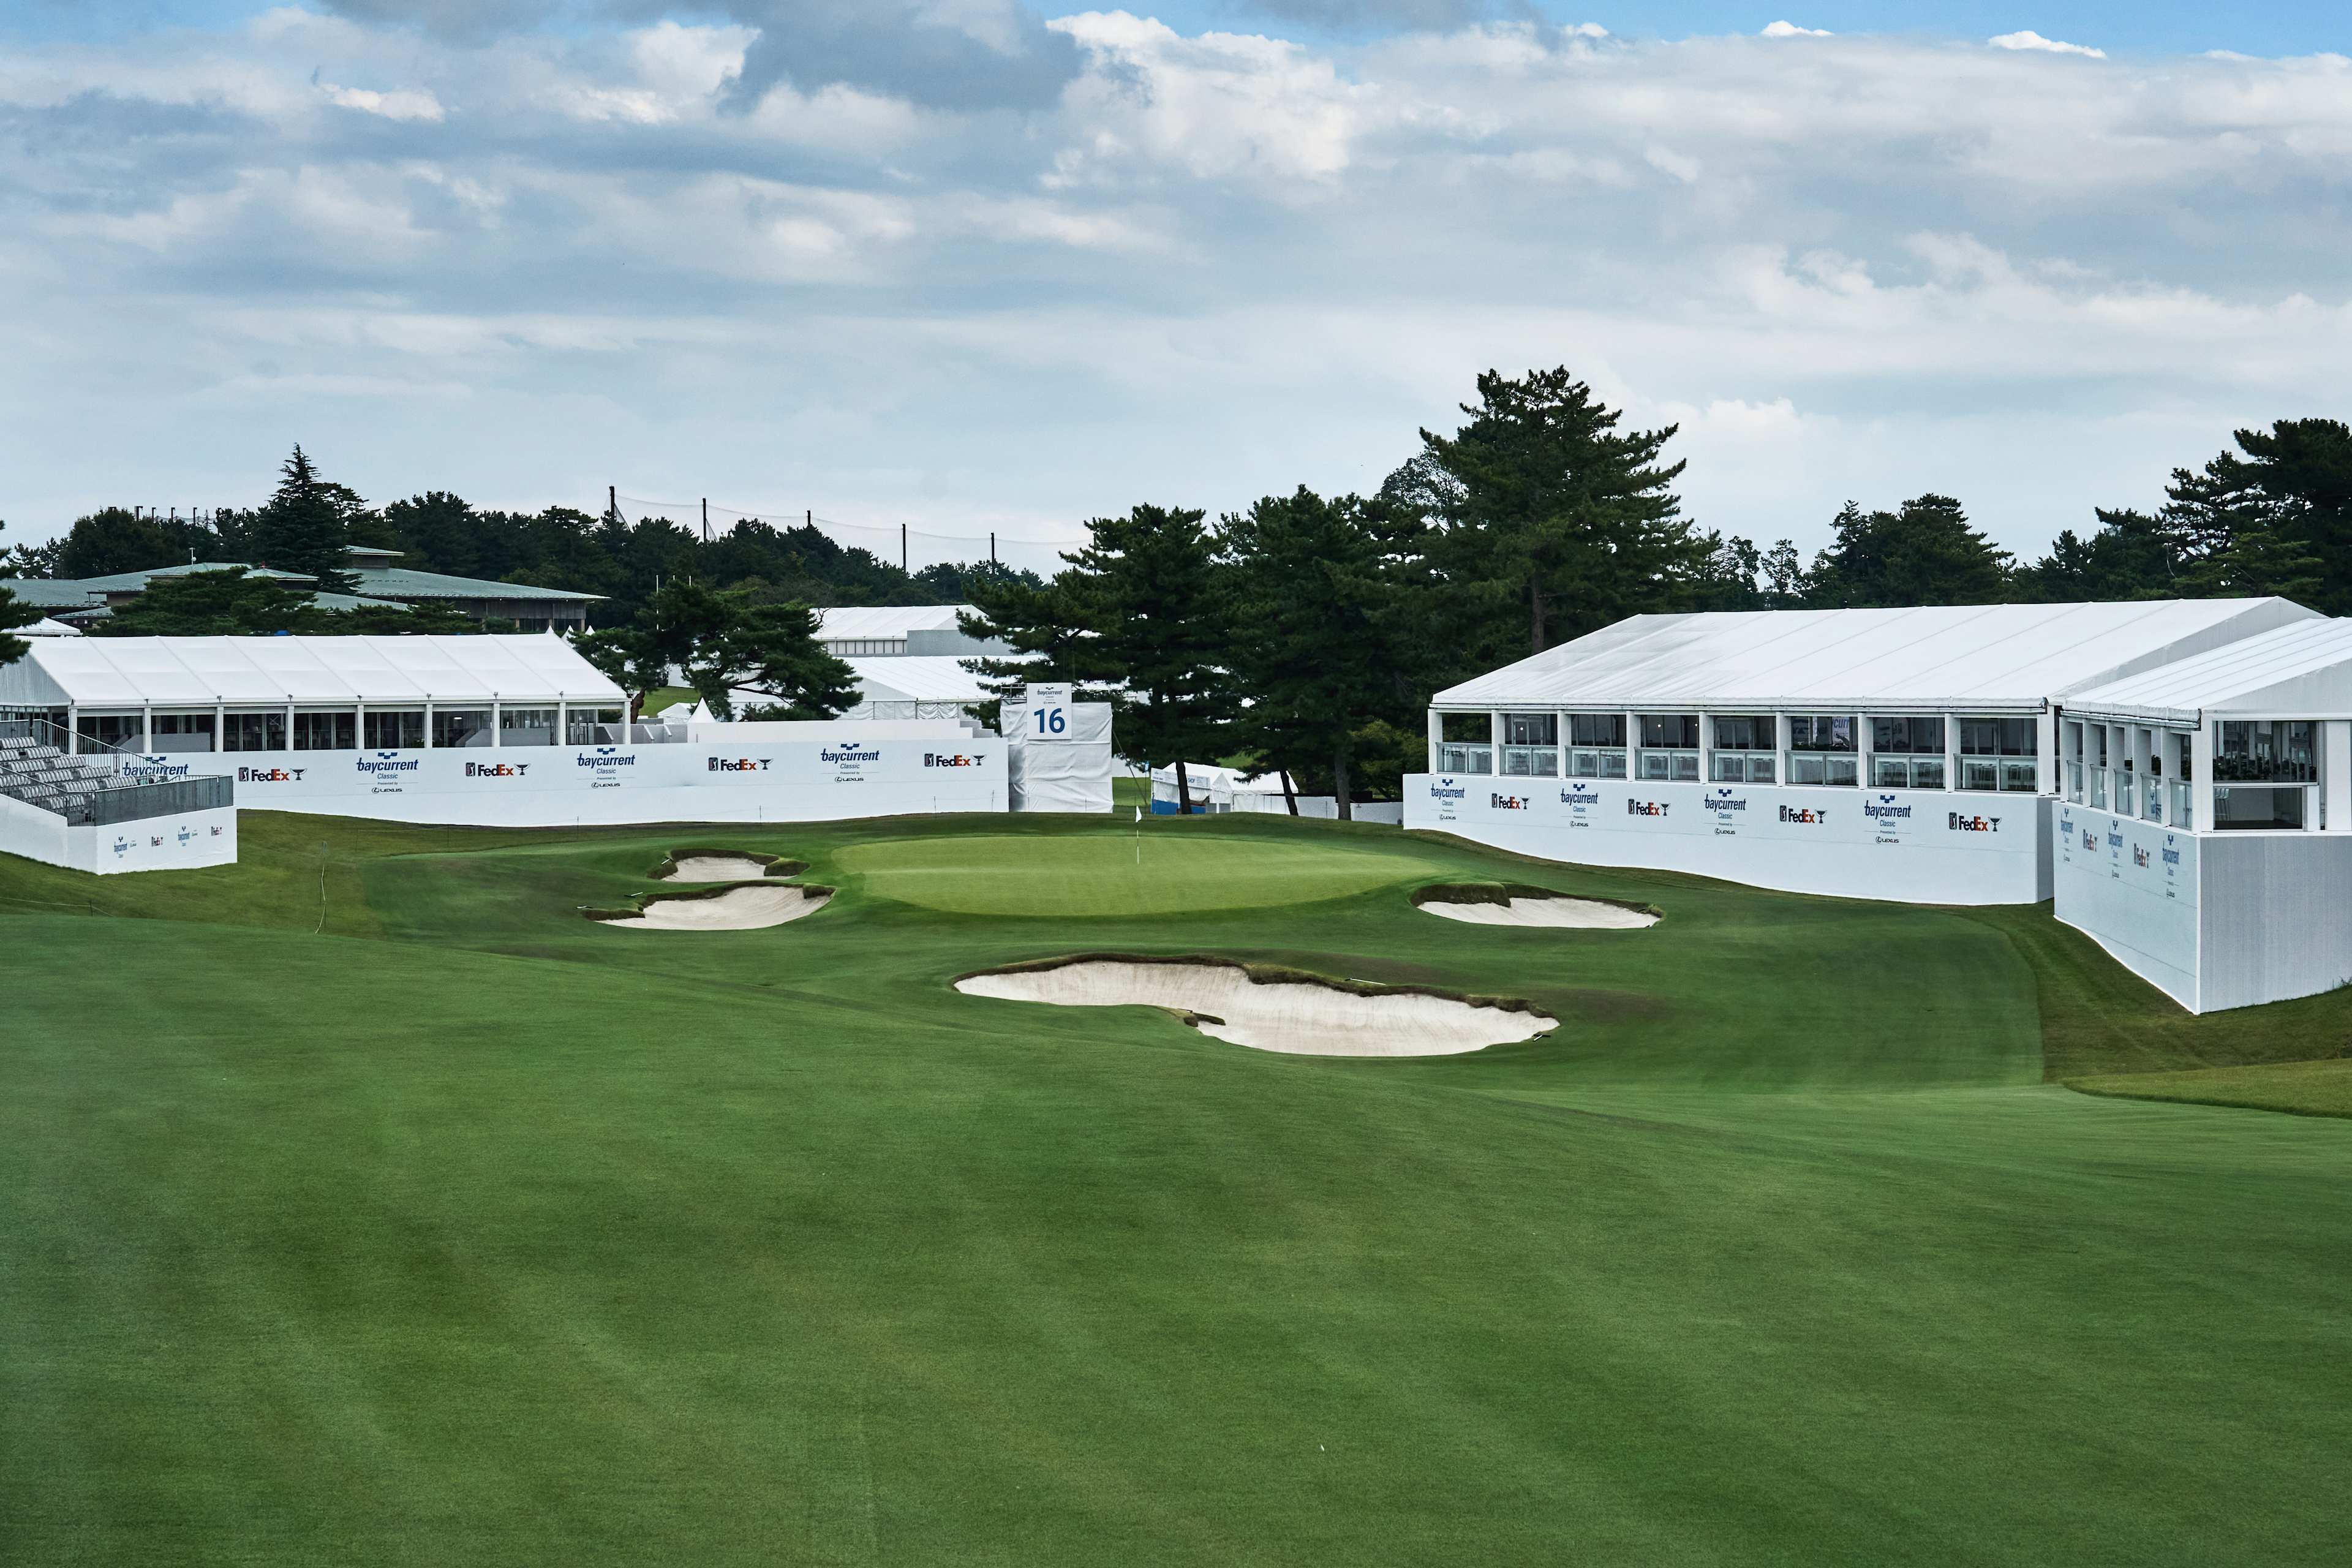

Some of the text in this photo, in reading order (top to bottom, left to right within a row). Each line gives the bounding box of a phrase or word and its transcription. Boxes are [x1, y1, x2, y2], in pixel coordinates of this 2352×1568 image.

[1034, 708, 1065, 733] 16
[577, 753, 635, 769] baycurrent
[821, 748, 880, 764] baycurrent
[936, 755, 971, 767] FedEx
[356, 757, 418, 774] baycurrent
[478, 764, 514, 777] FedEx
[720, 759, 757, 771] FedEx
[251, 769, 290, 782] FedEx
[1431, 783, 1465, 800] baycurrent
[1561, 788, 1598, 806] baycurrent
[1499, 796, 1520, 809] FedEx
[1636, 802, 1659, 816] FedEx
[1704, 794, 1746, 812] baycurrent
[1864, 800, 1911, 820] baycurrent
[1789, 809, 1815, 823] FedEx
[1959, 816, 1988, 831] FedEx
